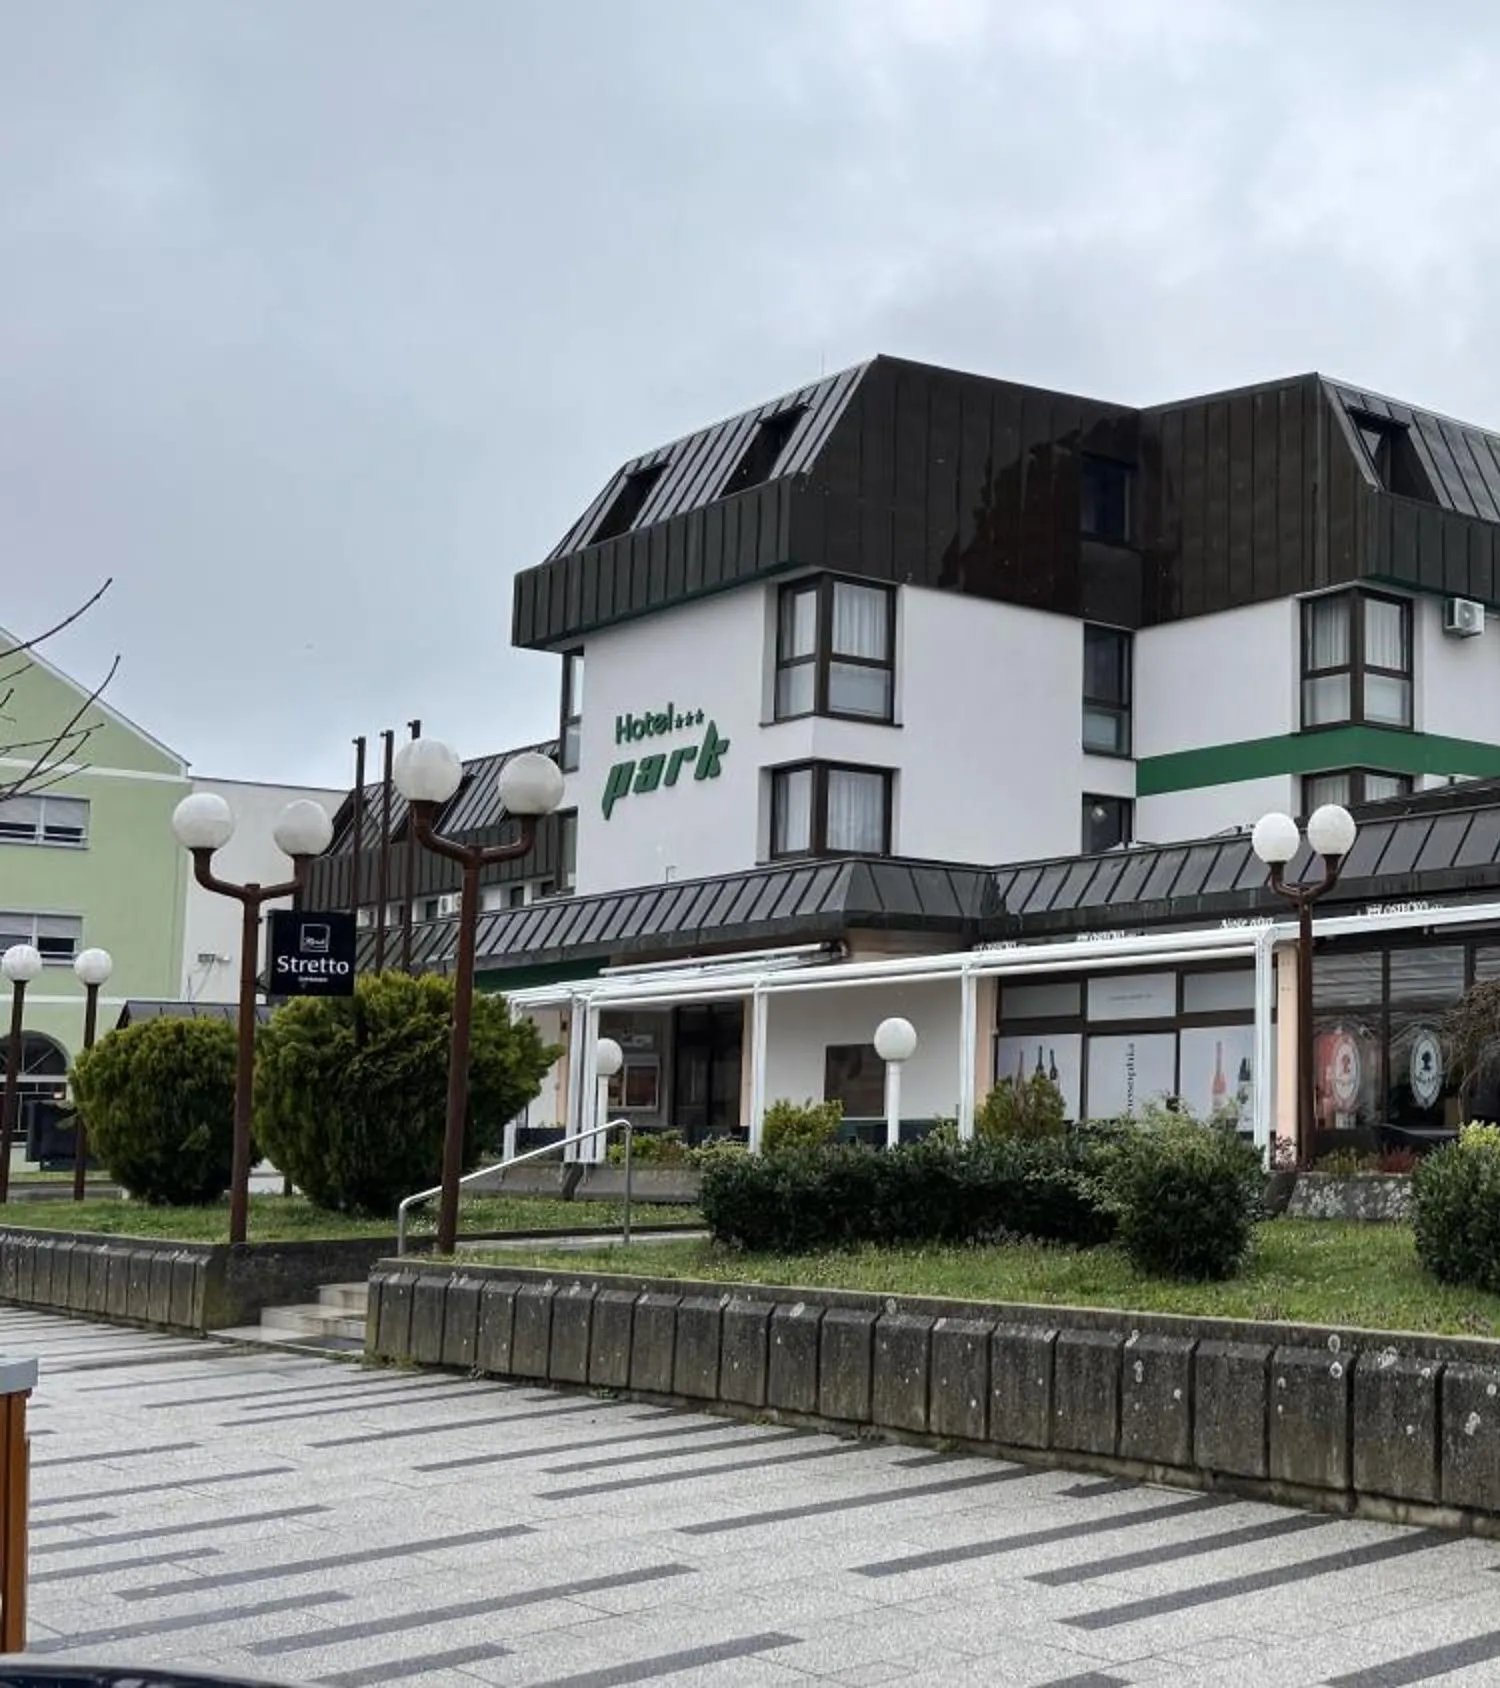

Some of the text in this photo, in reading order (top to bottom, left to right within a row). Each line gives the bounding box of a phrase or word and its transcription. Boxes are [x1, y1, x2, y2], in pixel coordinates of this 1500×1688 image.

[615, 701, 674, 745] Hotel
[601, 719, 731, 821] park
[277, 955, 350, 975] Stretto
